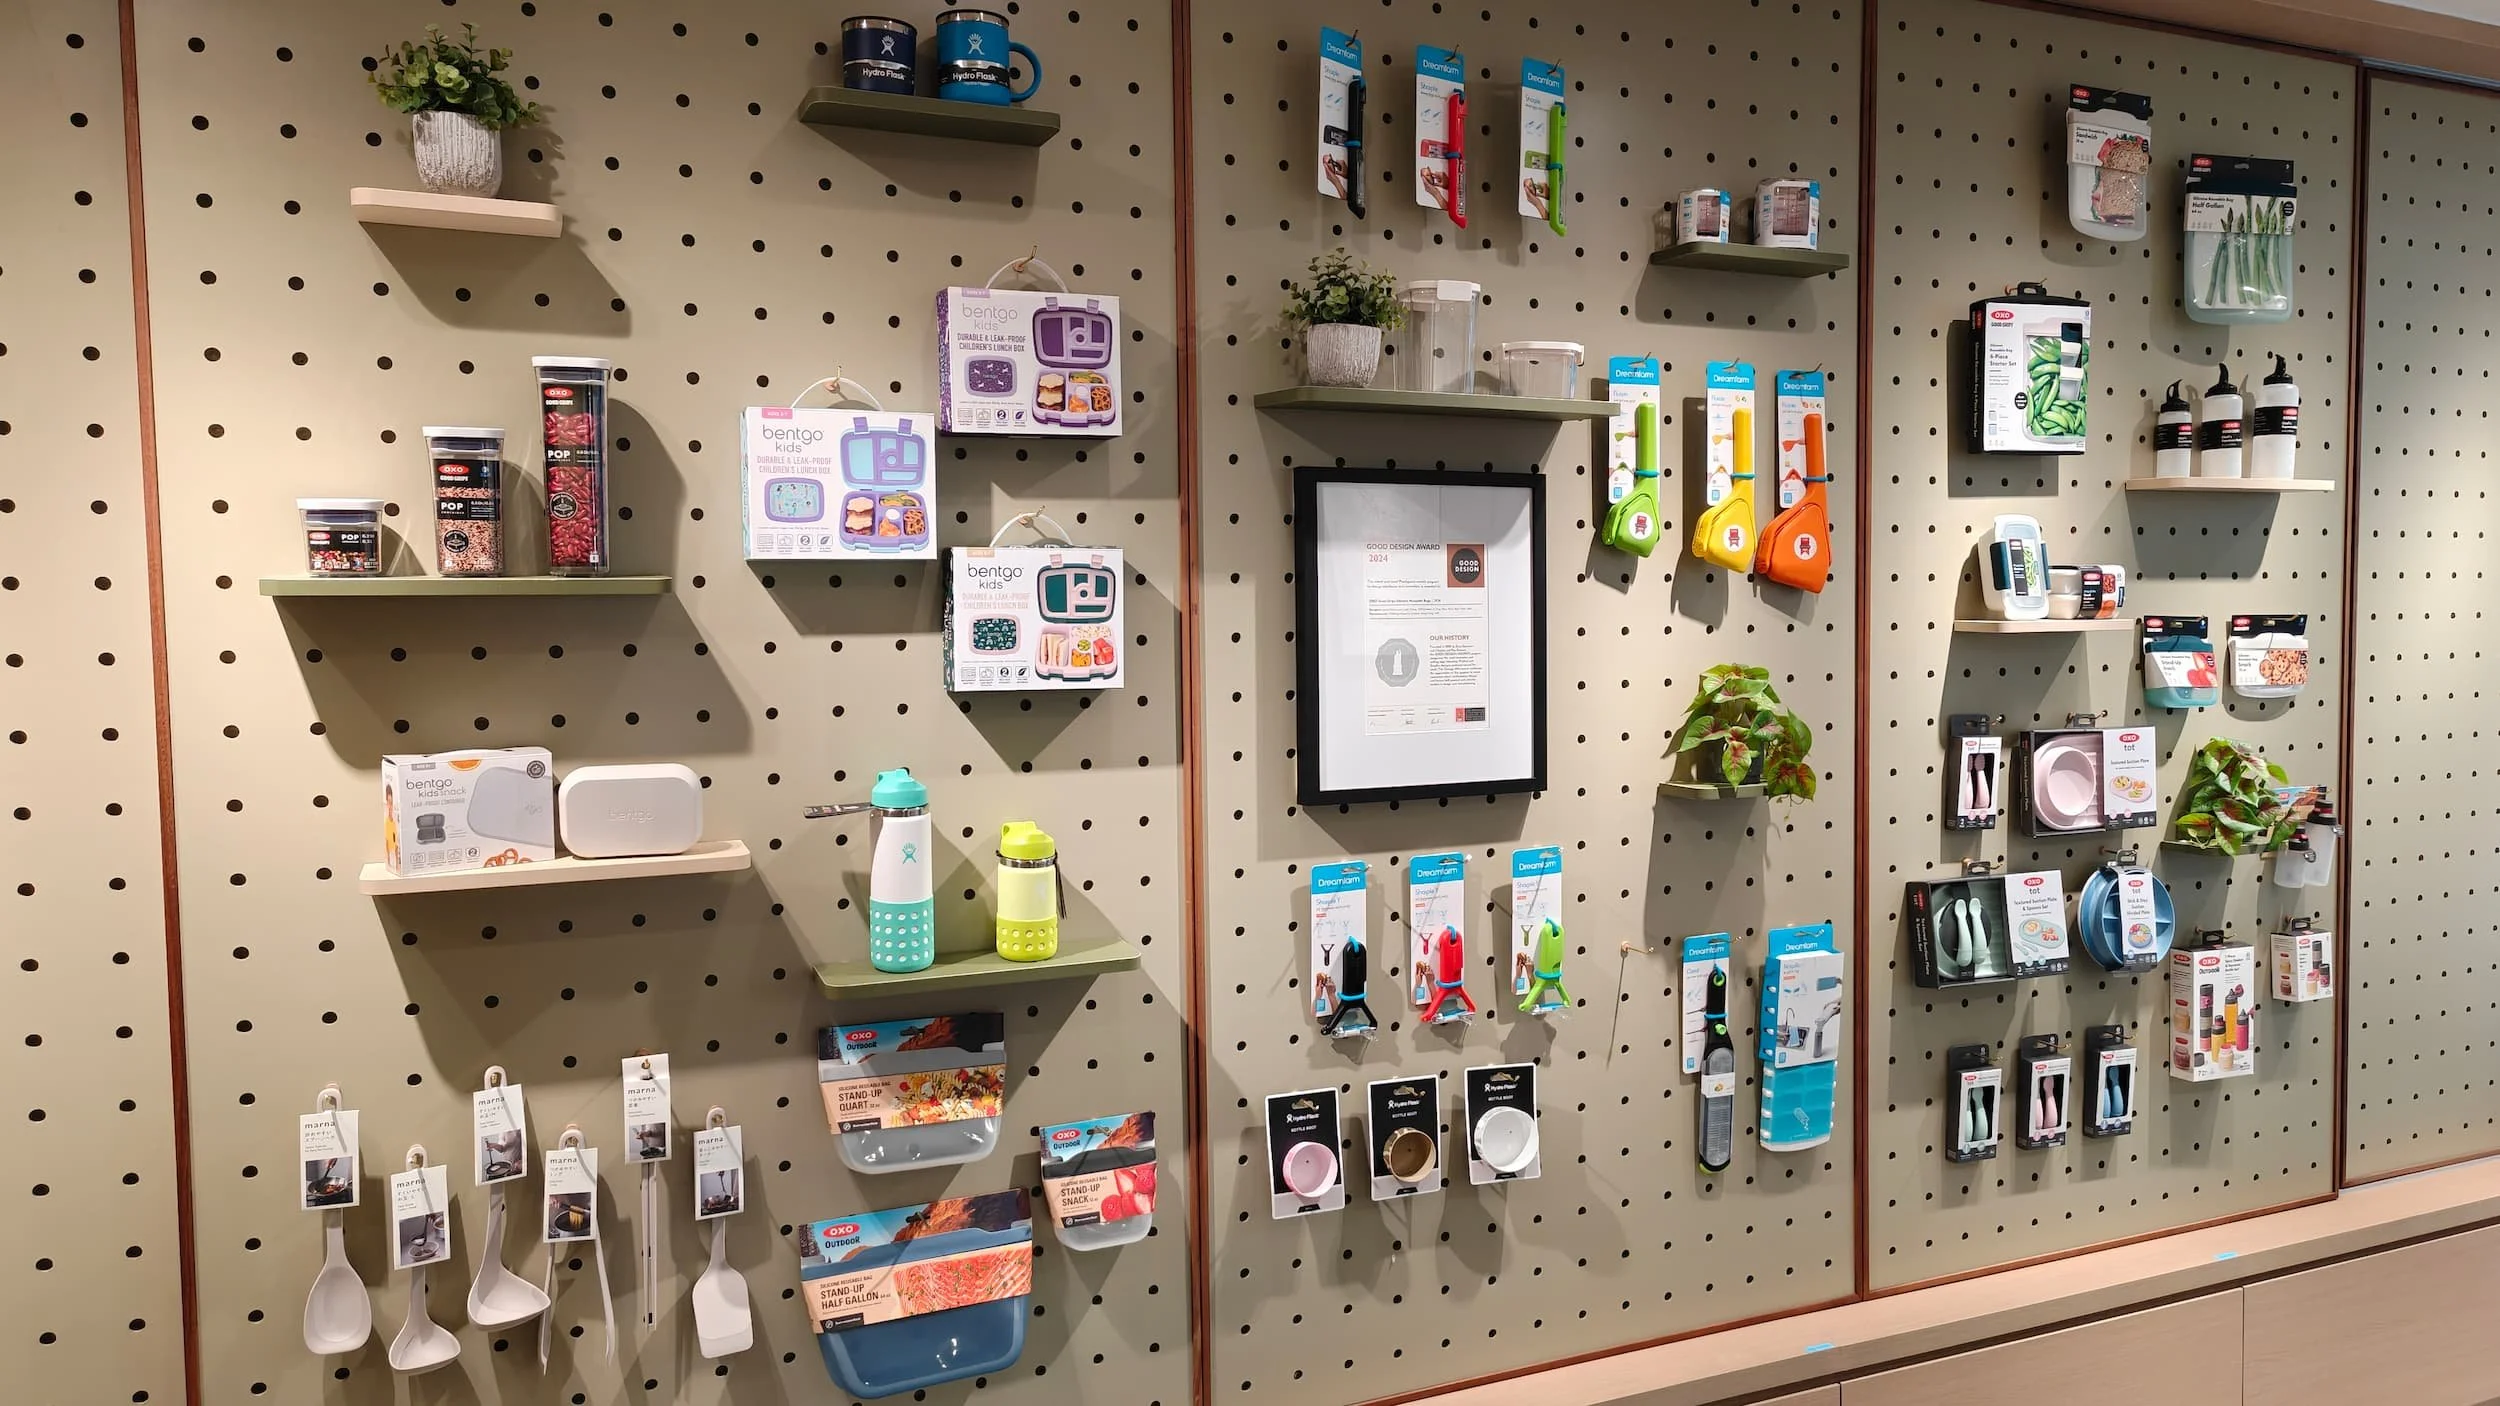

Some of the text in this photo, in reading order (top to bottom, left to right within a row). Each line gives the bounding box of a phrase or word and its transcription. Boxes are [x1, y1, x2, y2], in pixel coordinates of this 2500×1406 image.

[1326, 42, 1358, 63] Dreamfarm
[1422, 59, 1459, 76] Dreamfarm
[862, 68, 905, 81] Hydro Flask
[952, 72, 996, 82] Hydro Flask
[1527, 72, 1560, 88] Dreamfarm
[962, 303, 1018, 323] bentgo
[1994, 311, 2010, 319] OXO
[974, 319, 999, 330] kids
[957, 333, 983, 342] DURABLE
[991, 334, 1027, 343] LEAK-PROOF
[959, 342, 1025, 352] CHILDREN'S LUNCH BOX
[1615, 369, 1655, 379] Dreamfarm
[1713, 374, 1750, 384] Dreamfarm
[1783, 381, 1819, 391] Dreamfarm
[762, 424, 823, 445] bentgo
[775, 441, 802, 453] kids
[547, 449, 571, 458] POP
[757, 455, 785, 464] DURABLE
[793, 456, 832, 465] LEAK-PROOF
[759, 465, 795, 474] CHILDREN'S
[796, 466, 818, 474] LUNCH
[441, 502, 464, 511] POP
[341, 533, 360, 541] POP
[1415, 543, 1440, 551] AWARD
[1368, 554, 1389, 563] 2024
[968, 563, 1023, 581] bentgo
[979, 579, 1004, 589] kids
[406, 778, 453, 791] bentgo
[418, 786, 466, 798] kids snack
[1518, 861, 1557, 871] Dreamfarm
[1417, 867, 1458, 878] Dreamfarm
[1318, 876, 1360, 887] Dreamfarm
[1688, 946, 1725, 956] Dreamfarm
[1785, 942, 1818, 951] Dreamfarm
[2202, 958, 2218, 966] OXO
[851, 1031, 873, 1041] OXO
[846, 1041, 878, 1051] OUTDOOR
[628, 1087, 656, 1095] marna
[838, 1089, 882, 1102] STAND-UP
[478, 1096, 505, 1106] marna
[840, 1101, 868, 1111] QUART
[304, 1121, 336, 1129] marna
[1057, 1130, 1076, 1139] OXO
[698, 1137, 724, 1145] marna
[1053, 1139, 1081, 1150] OUTDOOR
[396, 1178, 426, 1189] marna
[1060, 1183, 1101, 1197] STAND-UP
[1062, 1195, 1089, 1206] SNACK
[829, 1223, 854, 1236] OXO
[825, 1235, 861, 1249] OUTDOOR
[820, 1283, 865, 1300] STAND-UP
[821, 1297, 844, 1310] HALF
[845, 1291, 879, 1305] GALLON
